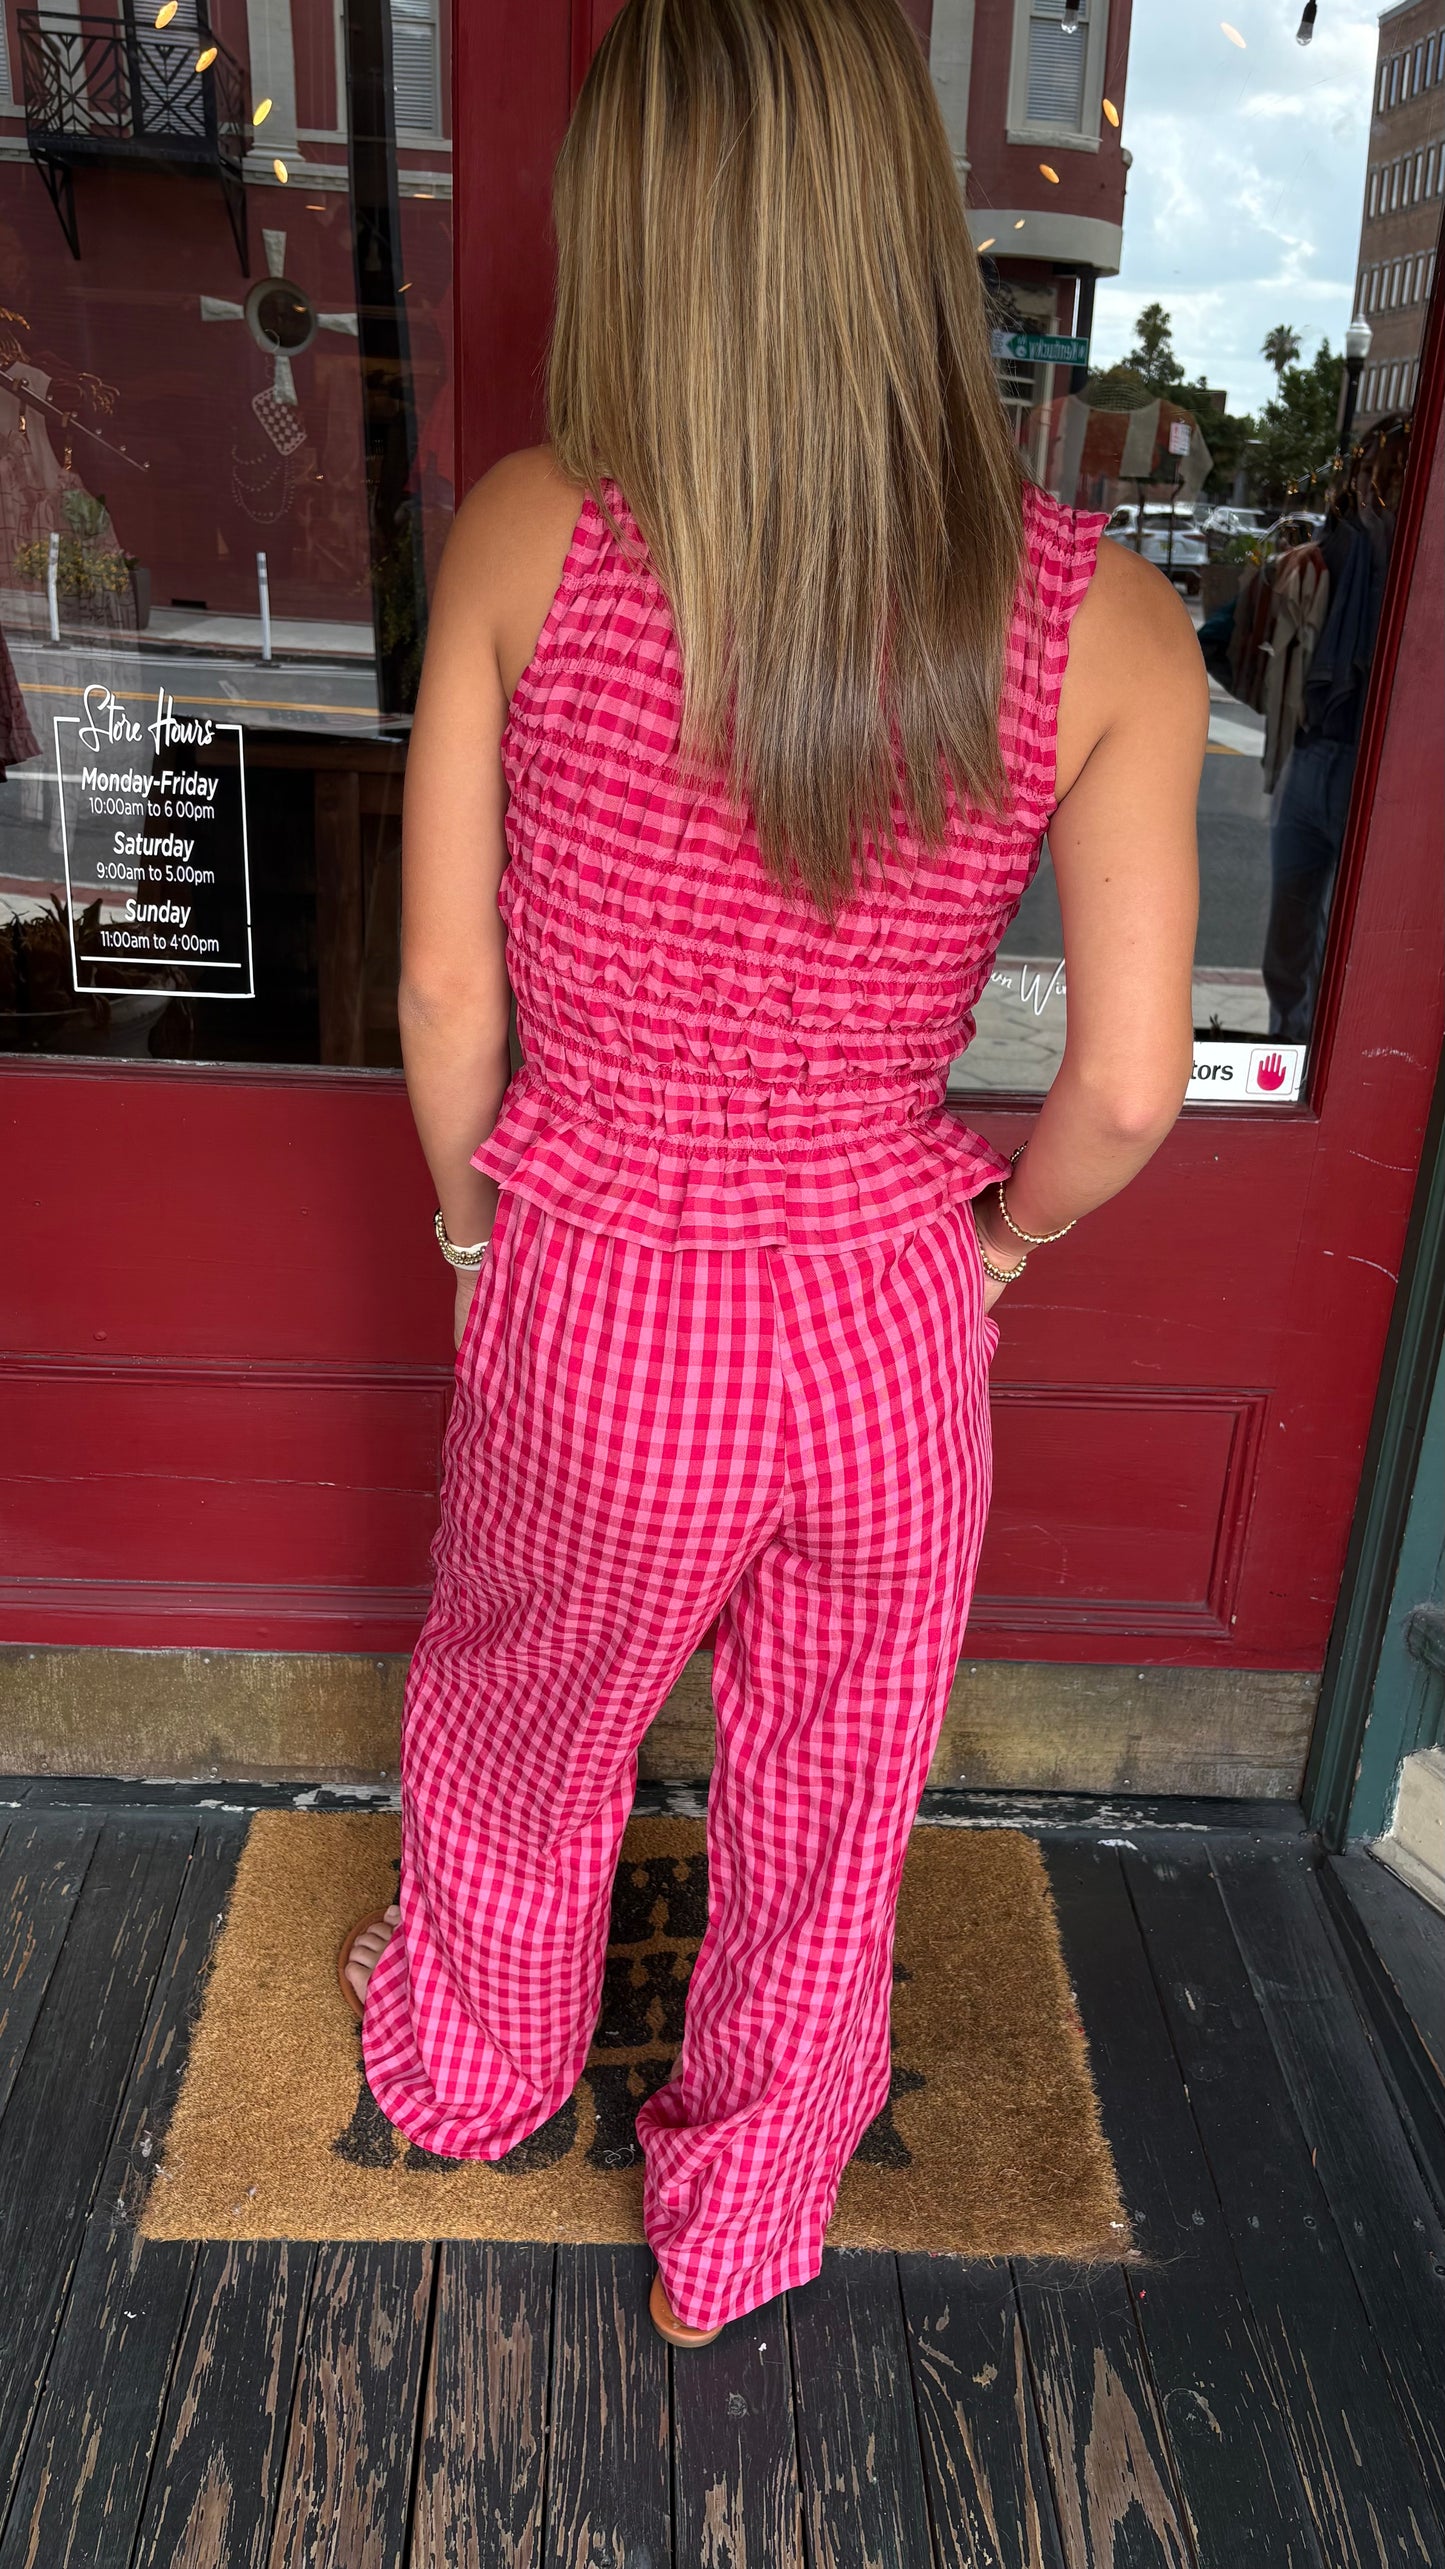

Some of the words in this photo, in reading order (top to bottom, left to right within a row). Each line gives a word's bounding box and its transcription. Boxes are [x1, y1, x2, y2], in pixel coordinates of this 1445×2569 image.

[79, 684, 142, 752] Store
[148, 687, 216, 755] Hours
[81, 767, 219, 800] Monday-Friday
[89, 797, 144, 816] 10:00am
[148, 800, 161, 817] to
[113, 831, 195, 862] Saturday
[96, 862, 146, 880] 9:00am
[149, 865, 162, 881] to
[125, 898, 191, 928] Sunday
[100, 931, 150, 949] 11:00am
[153, 934, 167, 950] to
